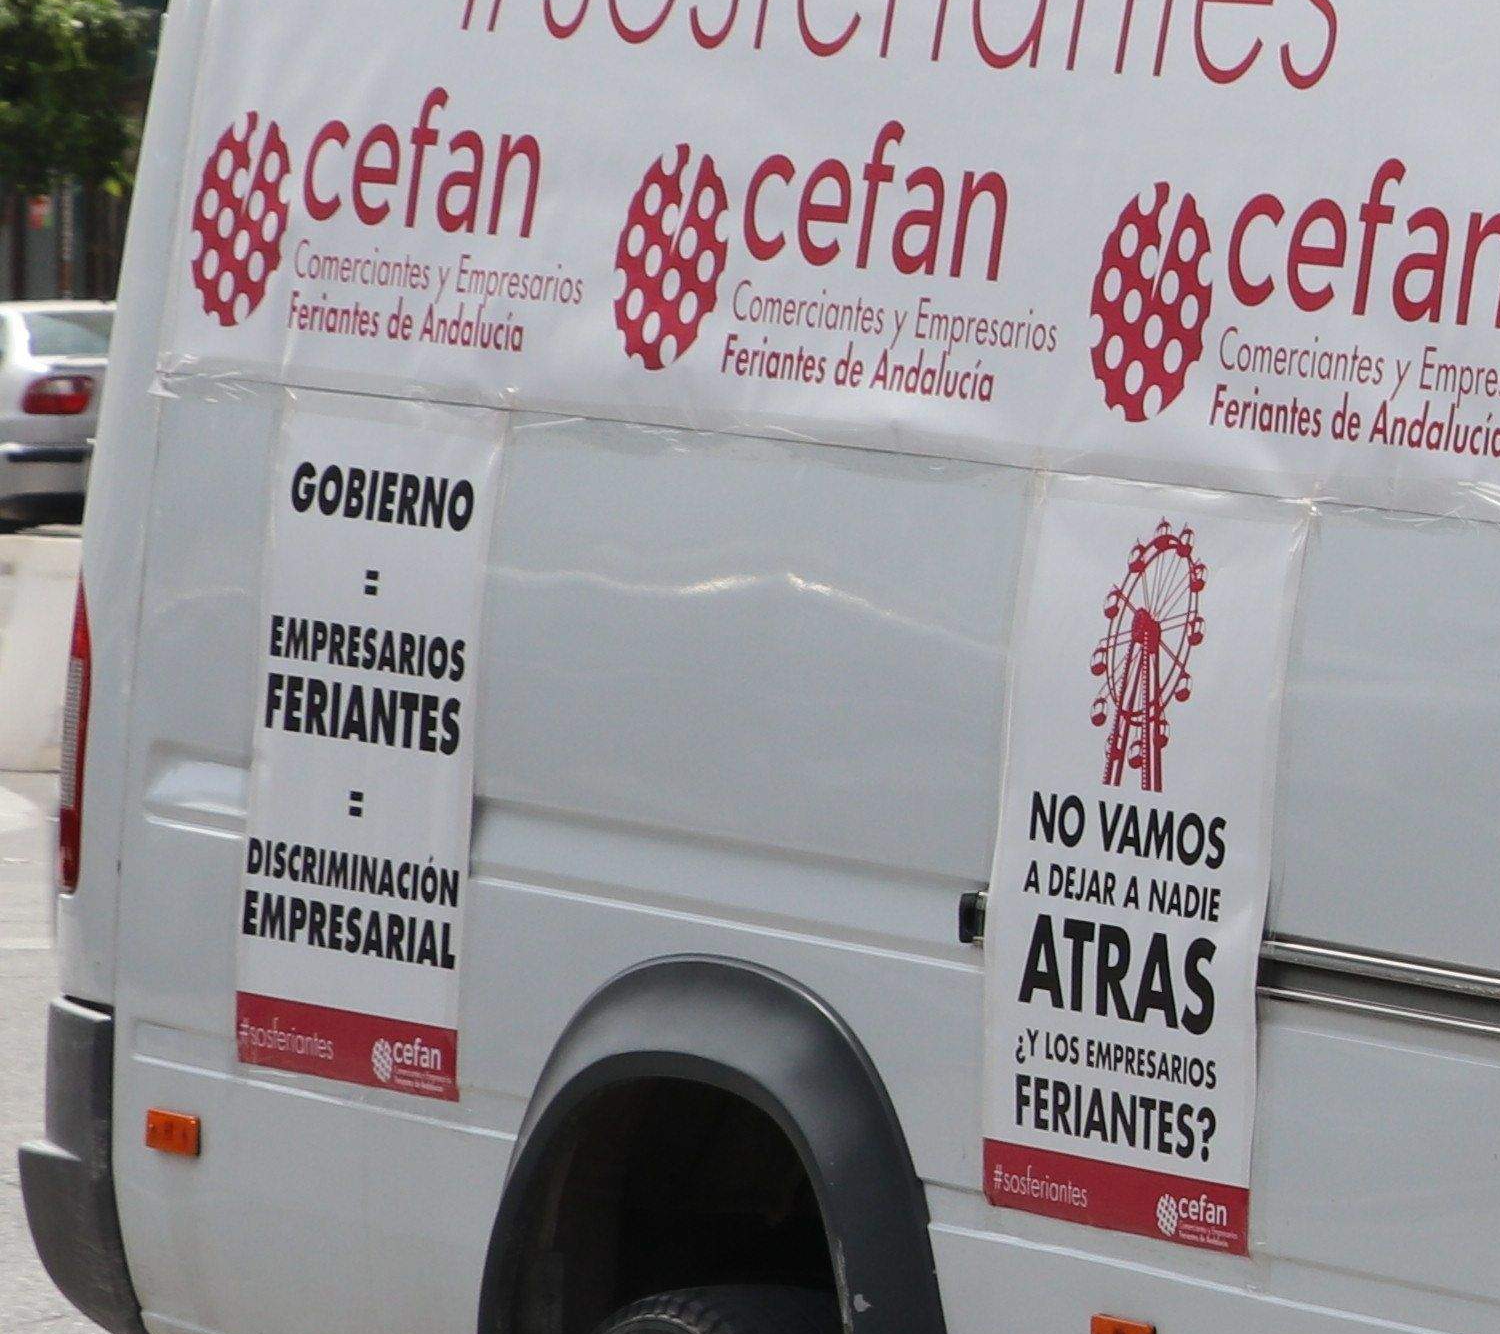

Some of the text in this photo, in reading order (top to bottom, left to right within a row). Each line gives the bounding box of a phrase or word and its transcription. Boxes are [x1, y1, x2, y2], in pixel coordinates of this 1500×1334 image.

[302, 86, 542, 238] cefan
[743, 119, 1009, 283] cefan
[294, 238, 584, 307] Comerciantes y Empresarios
[288, 290, 525, 353] Feriantes de Andalucía
[732, 279, 1058, 354] Comerciantes y Empresarios
[721, 333, 996, 403] Feriantes de Andalucía
[1219, 326, 1386, 386] Comerciantes
[1390, 358, 1412, 401] y
[1209, 383, 1323, 438] Feriantes
[1331, 392, 1361, 443] de
[291, 461, 474, 533] GOBIERNO
[269, 615, 466, 683] EMPRESARIOS
[264, 672, 461, 756] FERIANTES
[1029, 790, 1227, 870] NO VAMOS
[247, 837, 459, 908] DISCRIMINACIÓN
[1023, 860, 1222, 923] A DEJAR A NADIE
[242, 889, 456, 970] EMPRESARIAL
[1017, 913, 1218, 1036] ATRAS
[238, 1017, 334, 1061] #sosferiantes
[393, 1037, 442, 1071] cefan
[1015, 1028, 1218, 1091] ¿Y LOS EMPRESARIOS
[1014, 1073, 1217, 1163] FERIANTES?
[993, 1162, 1089, 1209] #sosferiantes
[1178, 1193, 1227, 1227] cefan
